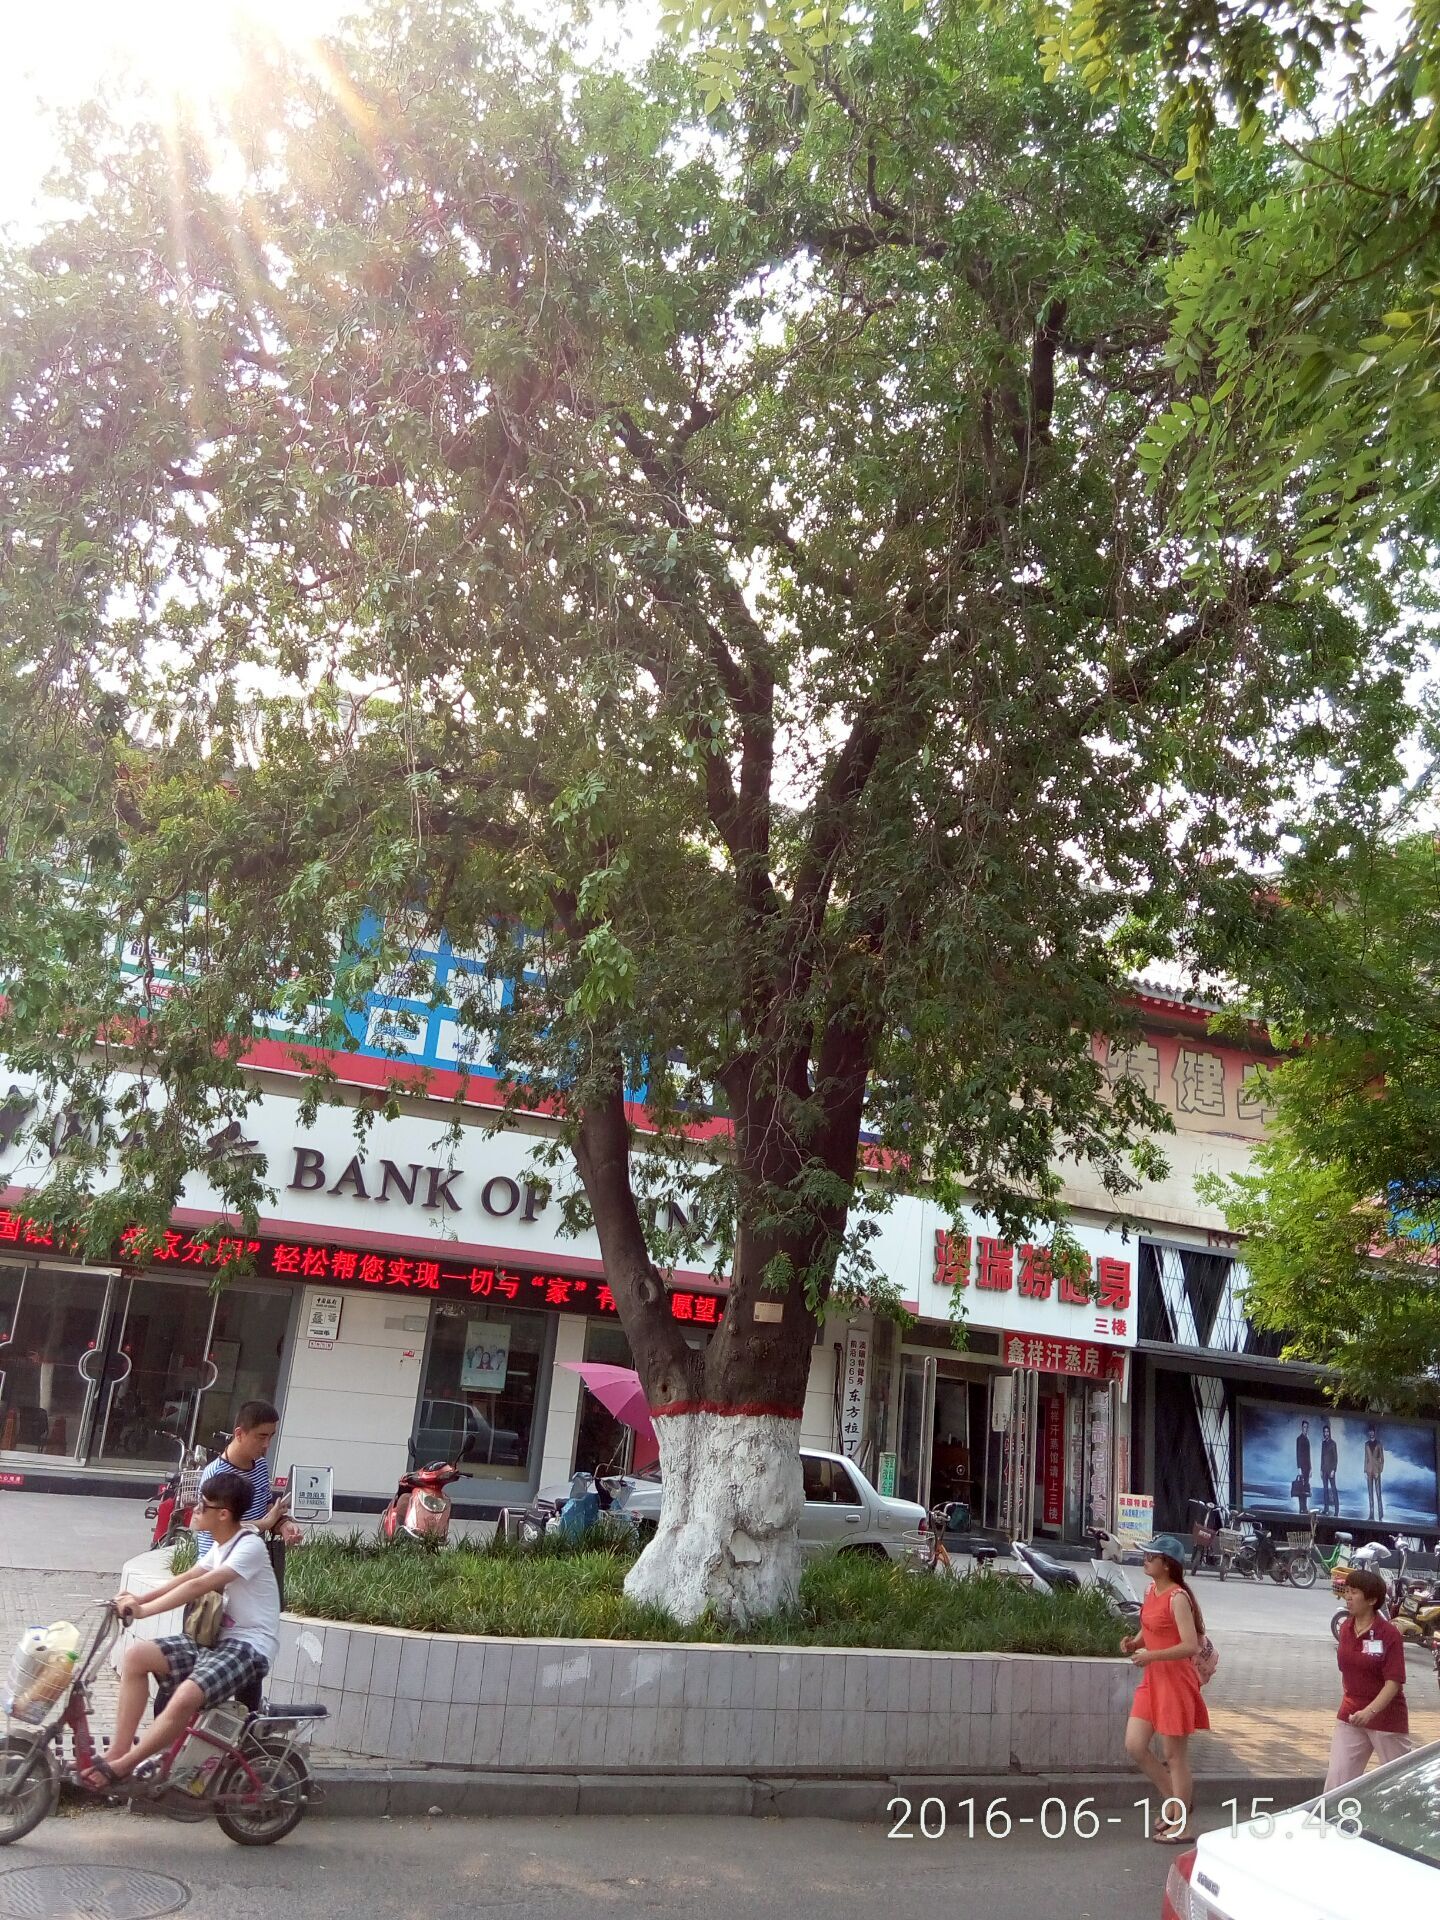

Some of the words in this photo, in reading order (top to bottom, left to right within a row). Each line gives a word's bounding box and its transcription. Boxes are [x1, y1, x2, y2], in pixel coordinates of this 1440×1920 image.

[286, 1146, 464, 1211] BANK
[1093, 1317, 1128, 1337] 三楼
[1007, 1336, 1100, 1376] 鑫祥汗蒸房
